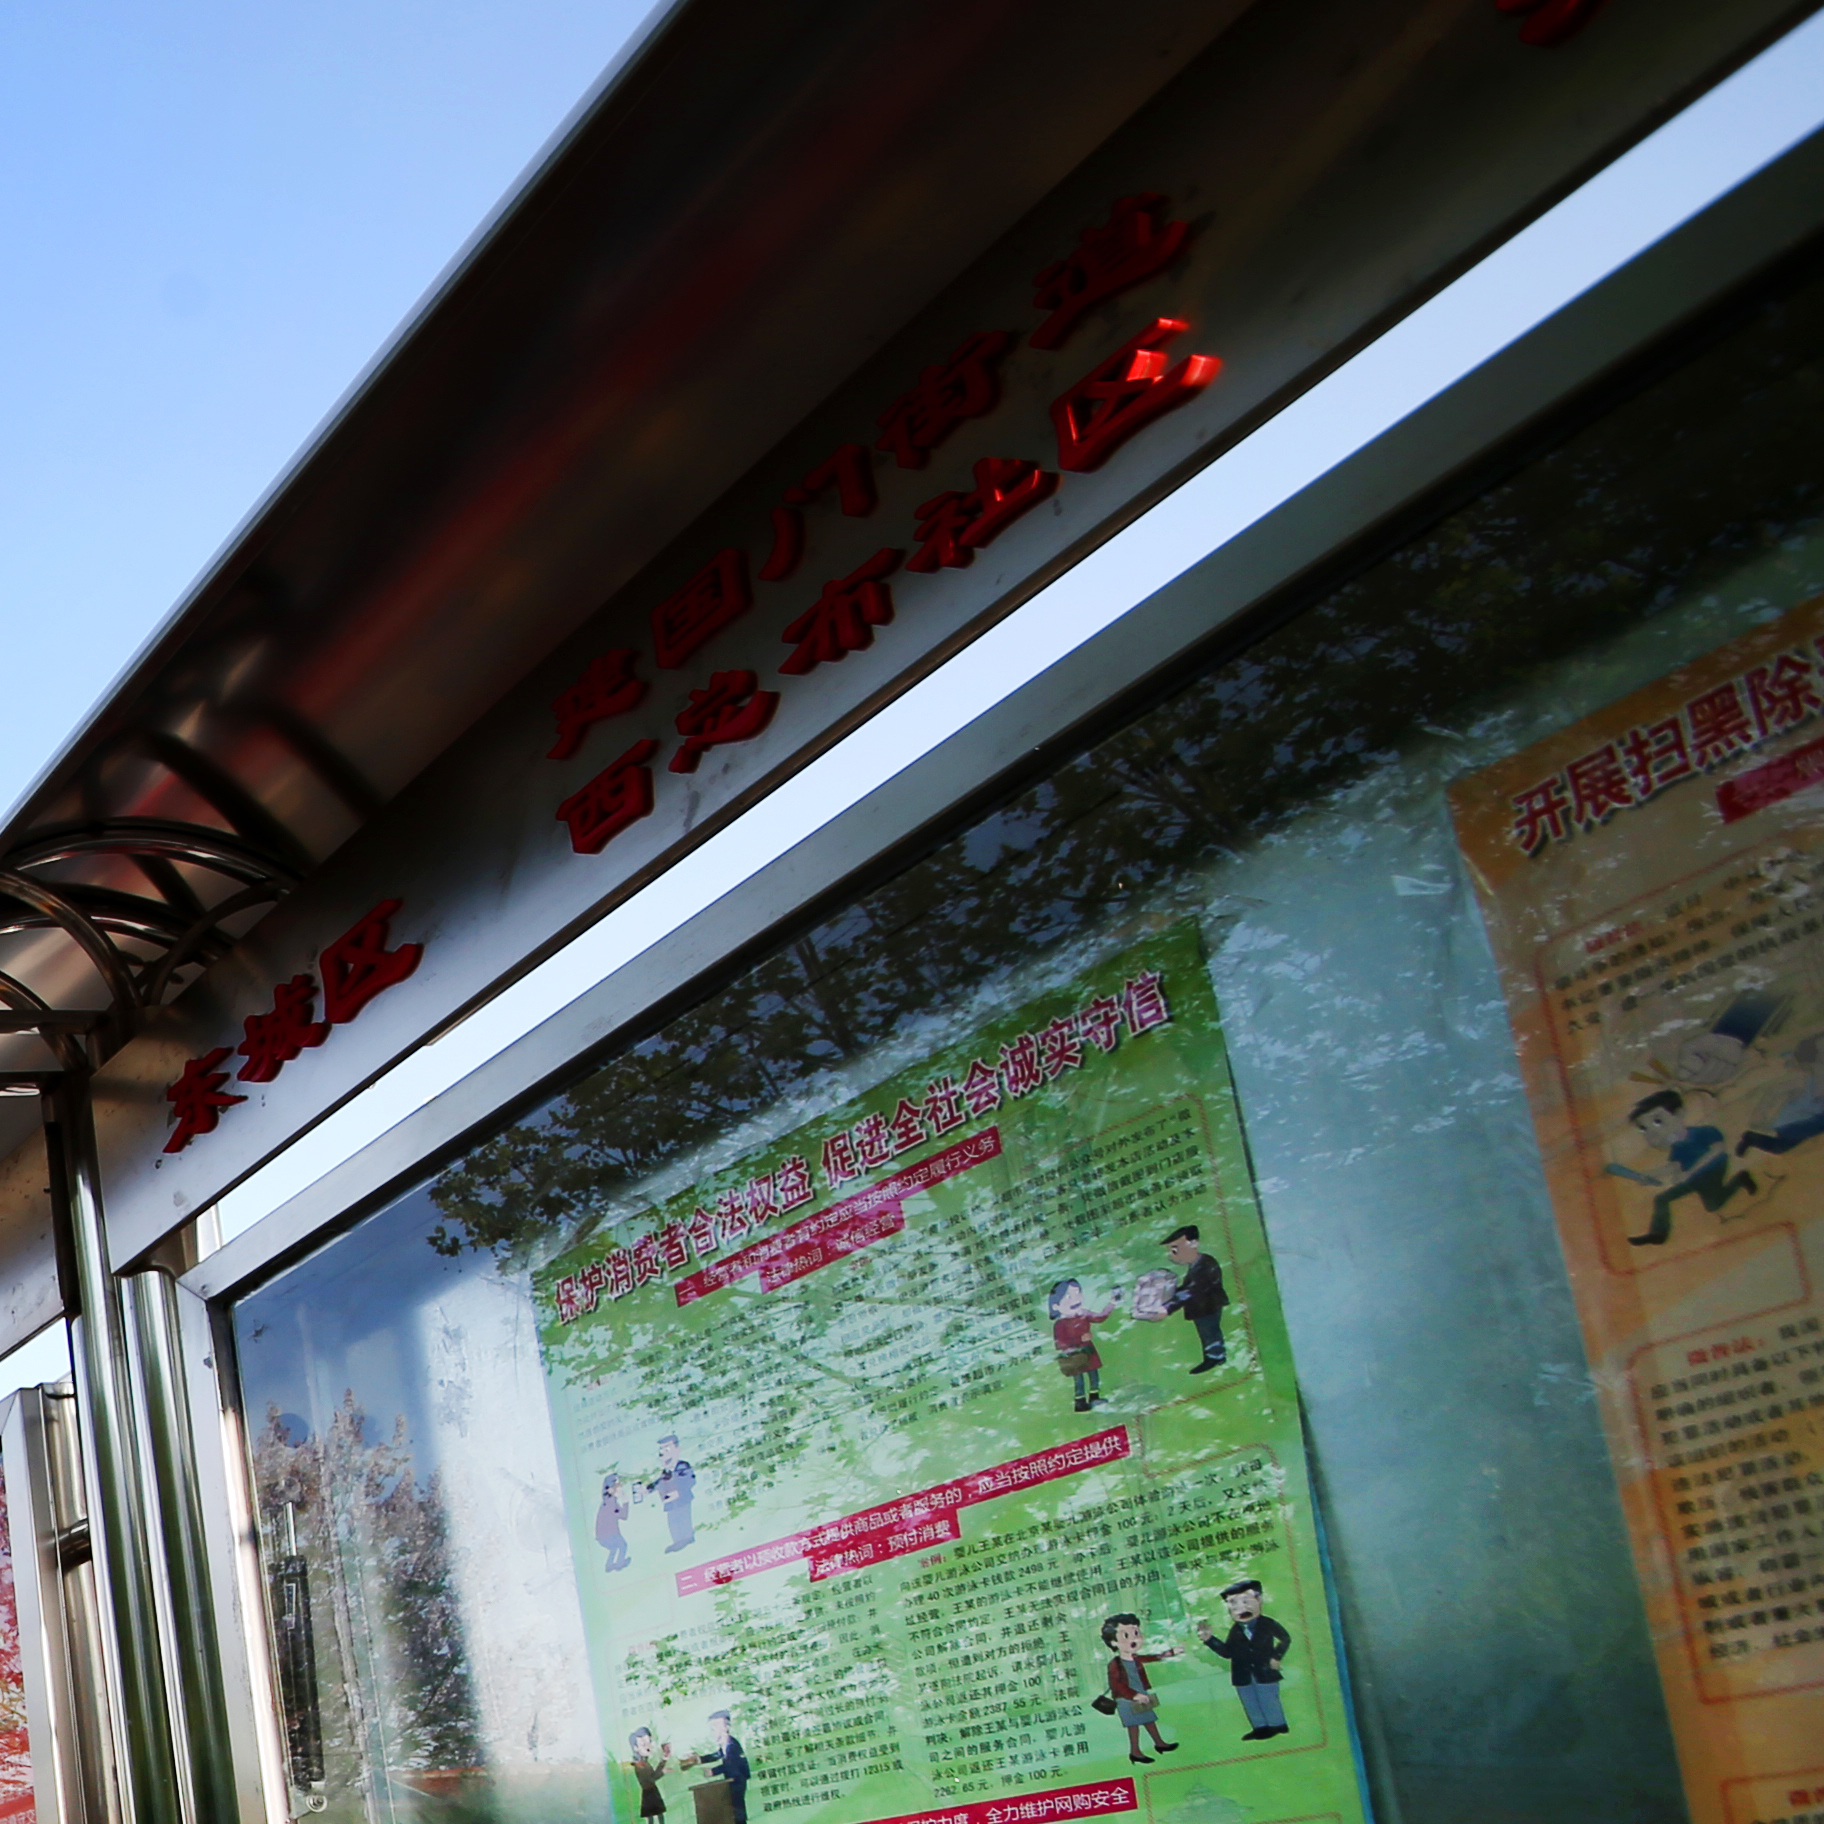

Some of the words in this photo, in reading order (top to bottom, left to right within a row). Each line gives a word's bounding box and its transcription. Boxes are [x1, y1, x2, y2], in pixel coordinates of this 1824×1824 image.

[555, 317, 1222, 856] 西总布社区
[1512, 633, 1824, 856] 开展扫黑除
[163, 899, 425, 1153] 东城区
[552, 1149, 816, 1328] 保护消费者合法权益
[817, 962, 1172, 1194] 促进全社会诚实守信
[814, 1517, 951, 1576] 法律热词：预付消费
